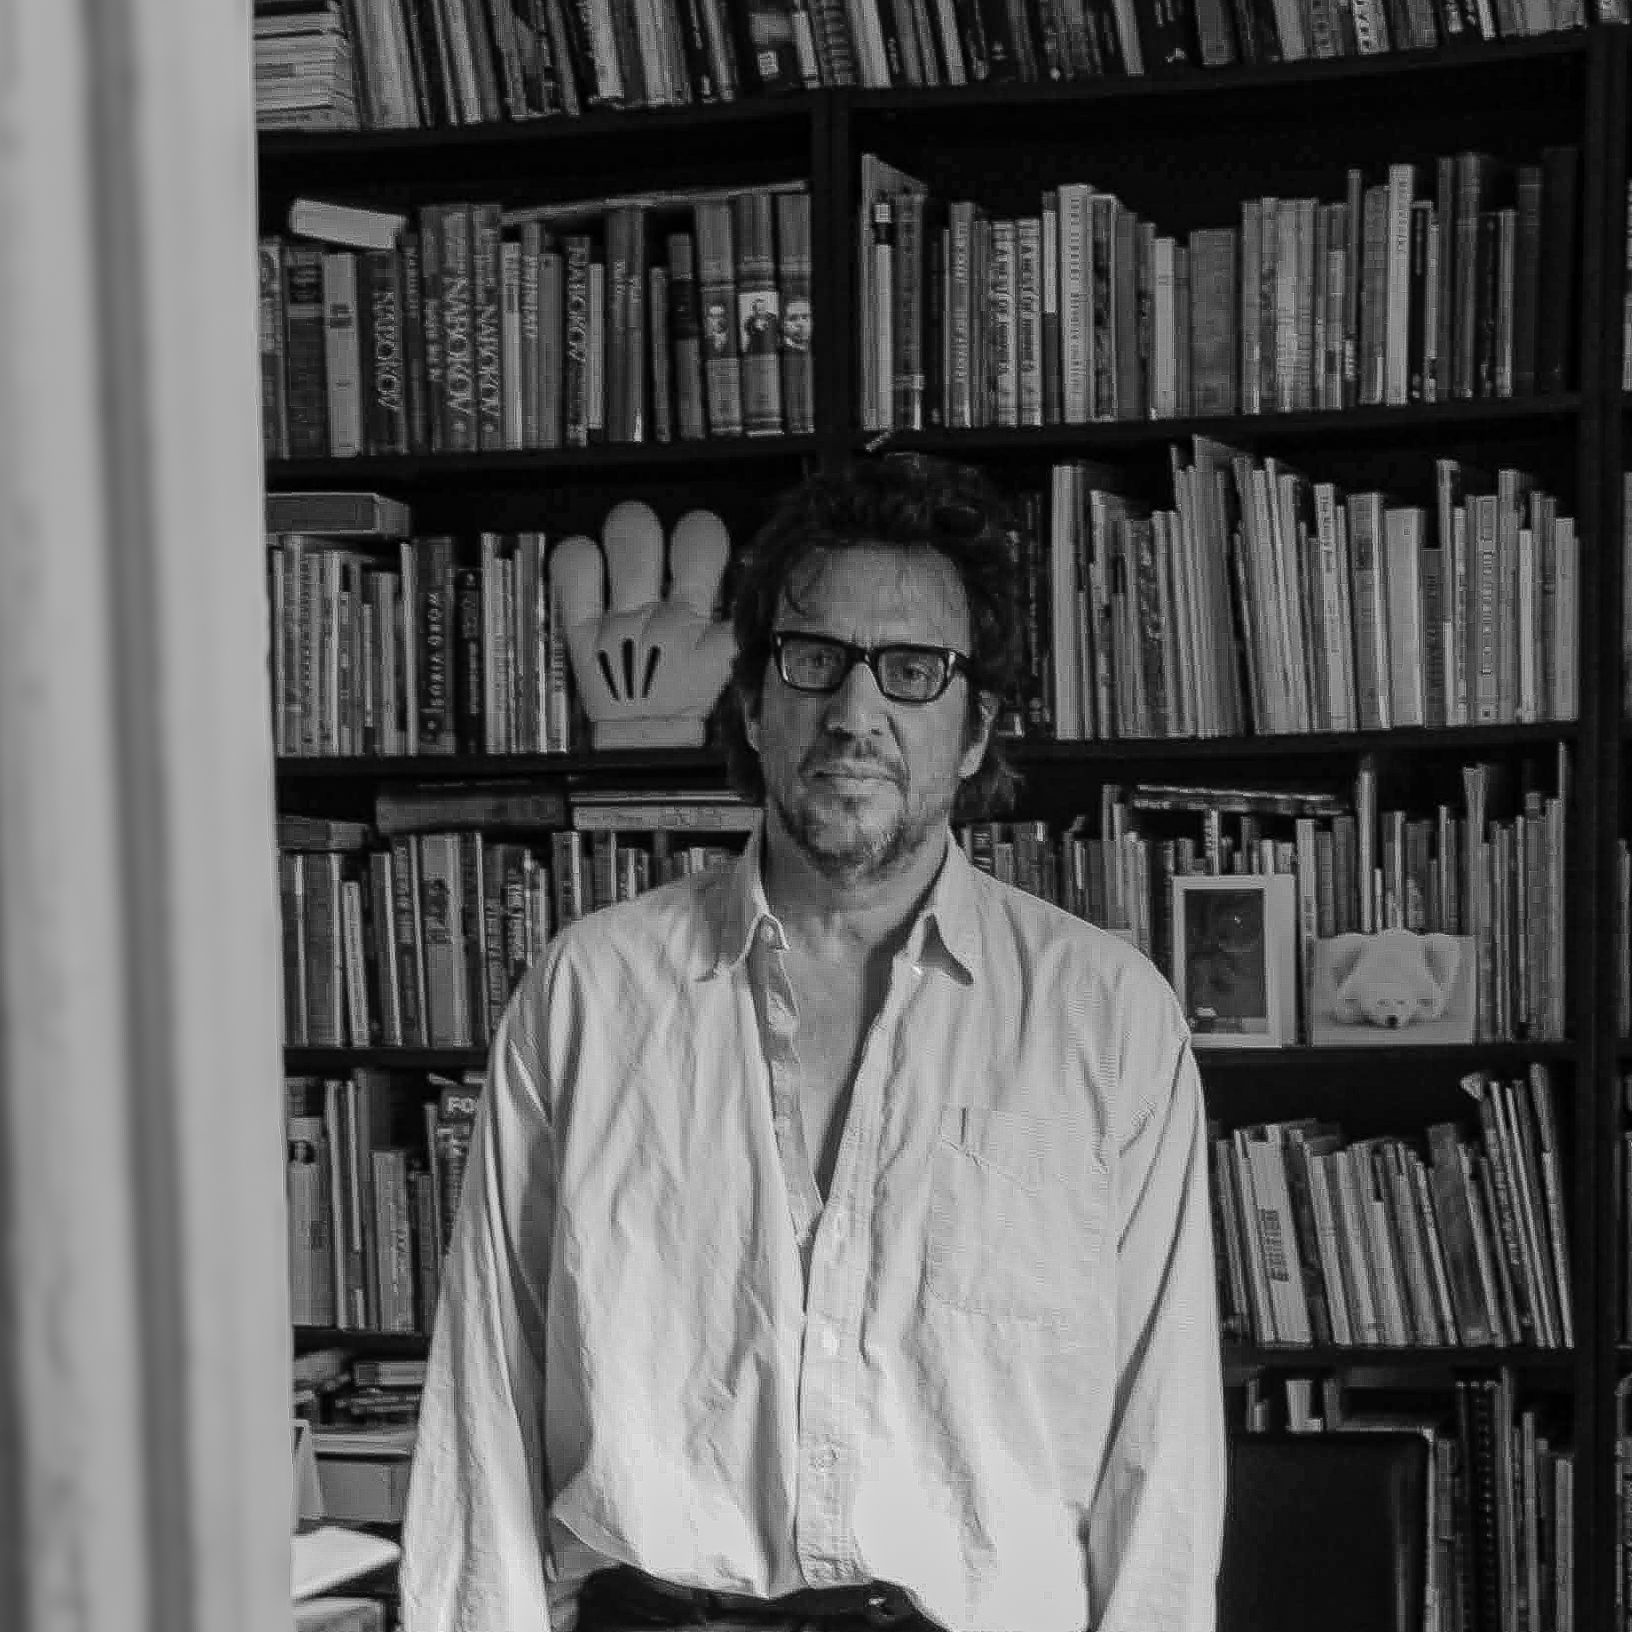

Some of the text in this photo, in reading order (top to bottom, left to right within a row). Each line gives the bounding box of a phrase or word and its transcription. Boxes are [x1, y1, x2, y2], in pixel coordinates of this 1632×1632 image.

[373, 291, 399, 411] NABOKOV
[444, 277, 472, 416] NABOKOV
[477, 303, 499, 417] NABOKOV
[566, 245, 588, 364] NABOKOV
[427, 591, 445, 708] WORD VIRUS
